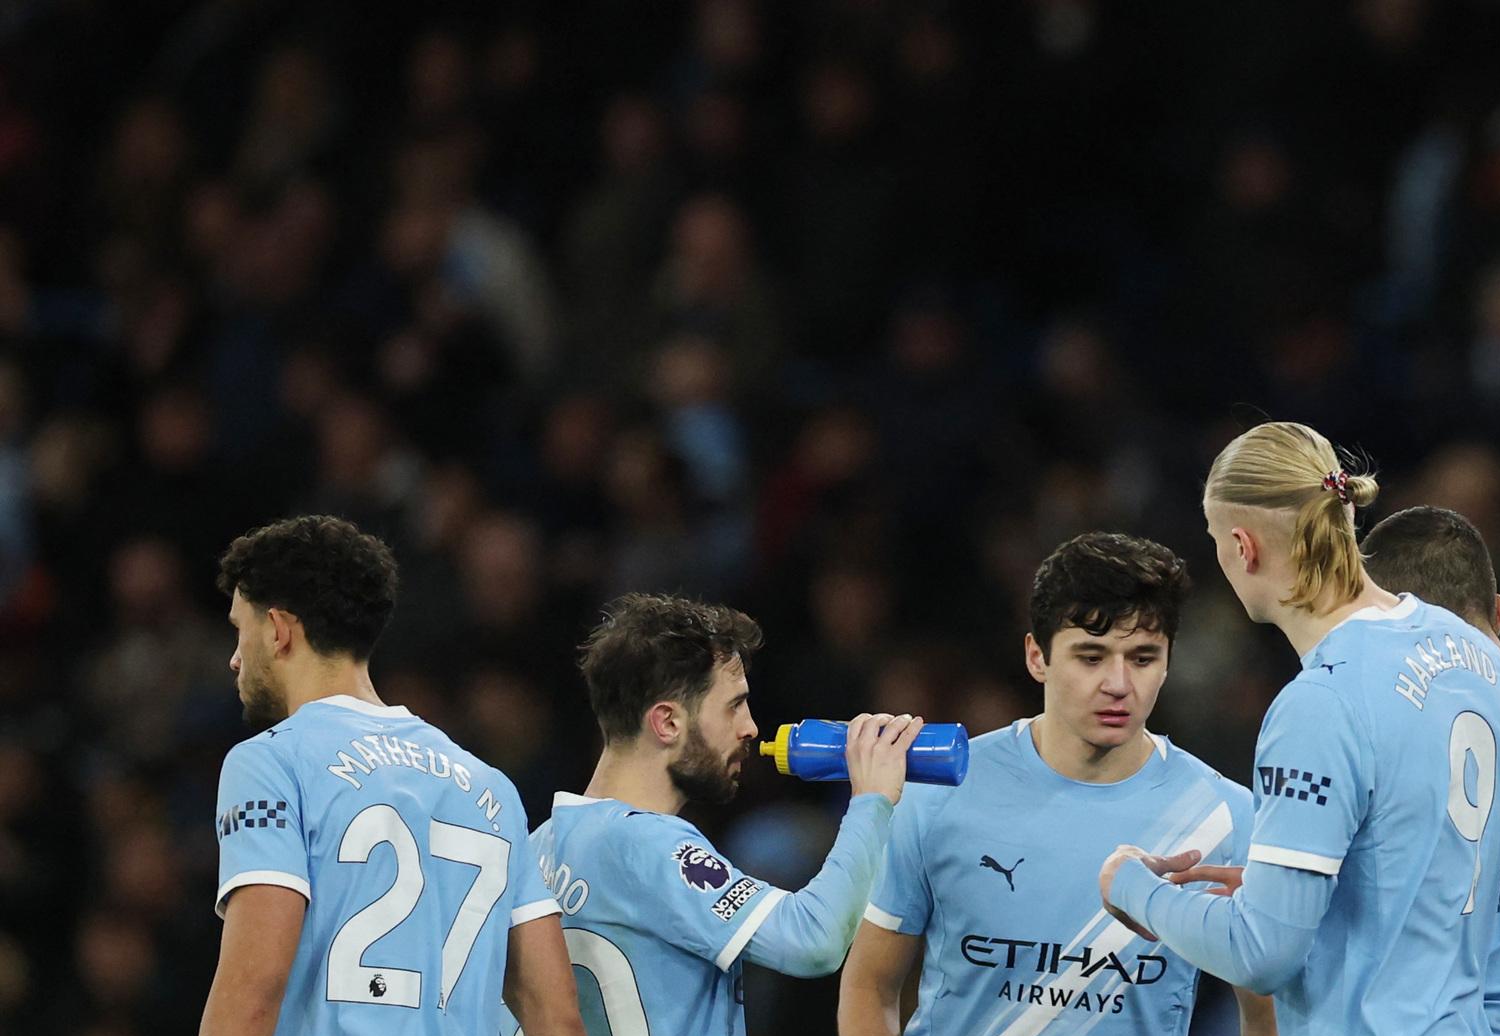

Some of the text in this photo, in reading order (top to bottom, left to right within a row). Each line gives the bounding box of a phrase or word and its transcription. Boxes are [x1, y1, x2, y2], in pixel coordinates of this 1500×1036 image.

[1394, 633, 1497, 711] HAALAND
[327, 734, 502, 833] MATHEUS N.
[1447, 709, 1497, 916] 9
[325, 803, 512, 1015] 27
[960, 933, 1167, 986] ETIHAD
[998, 983, 1125, 1015] AIRWAYS
